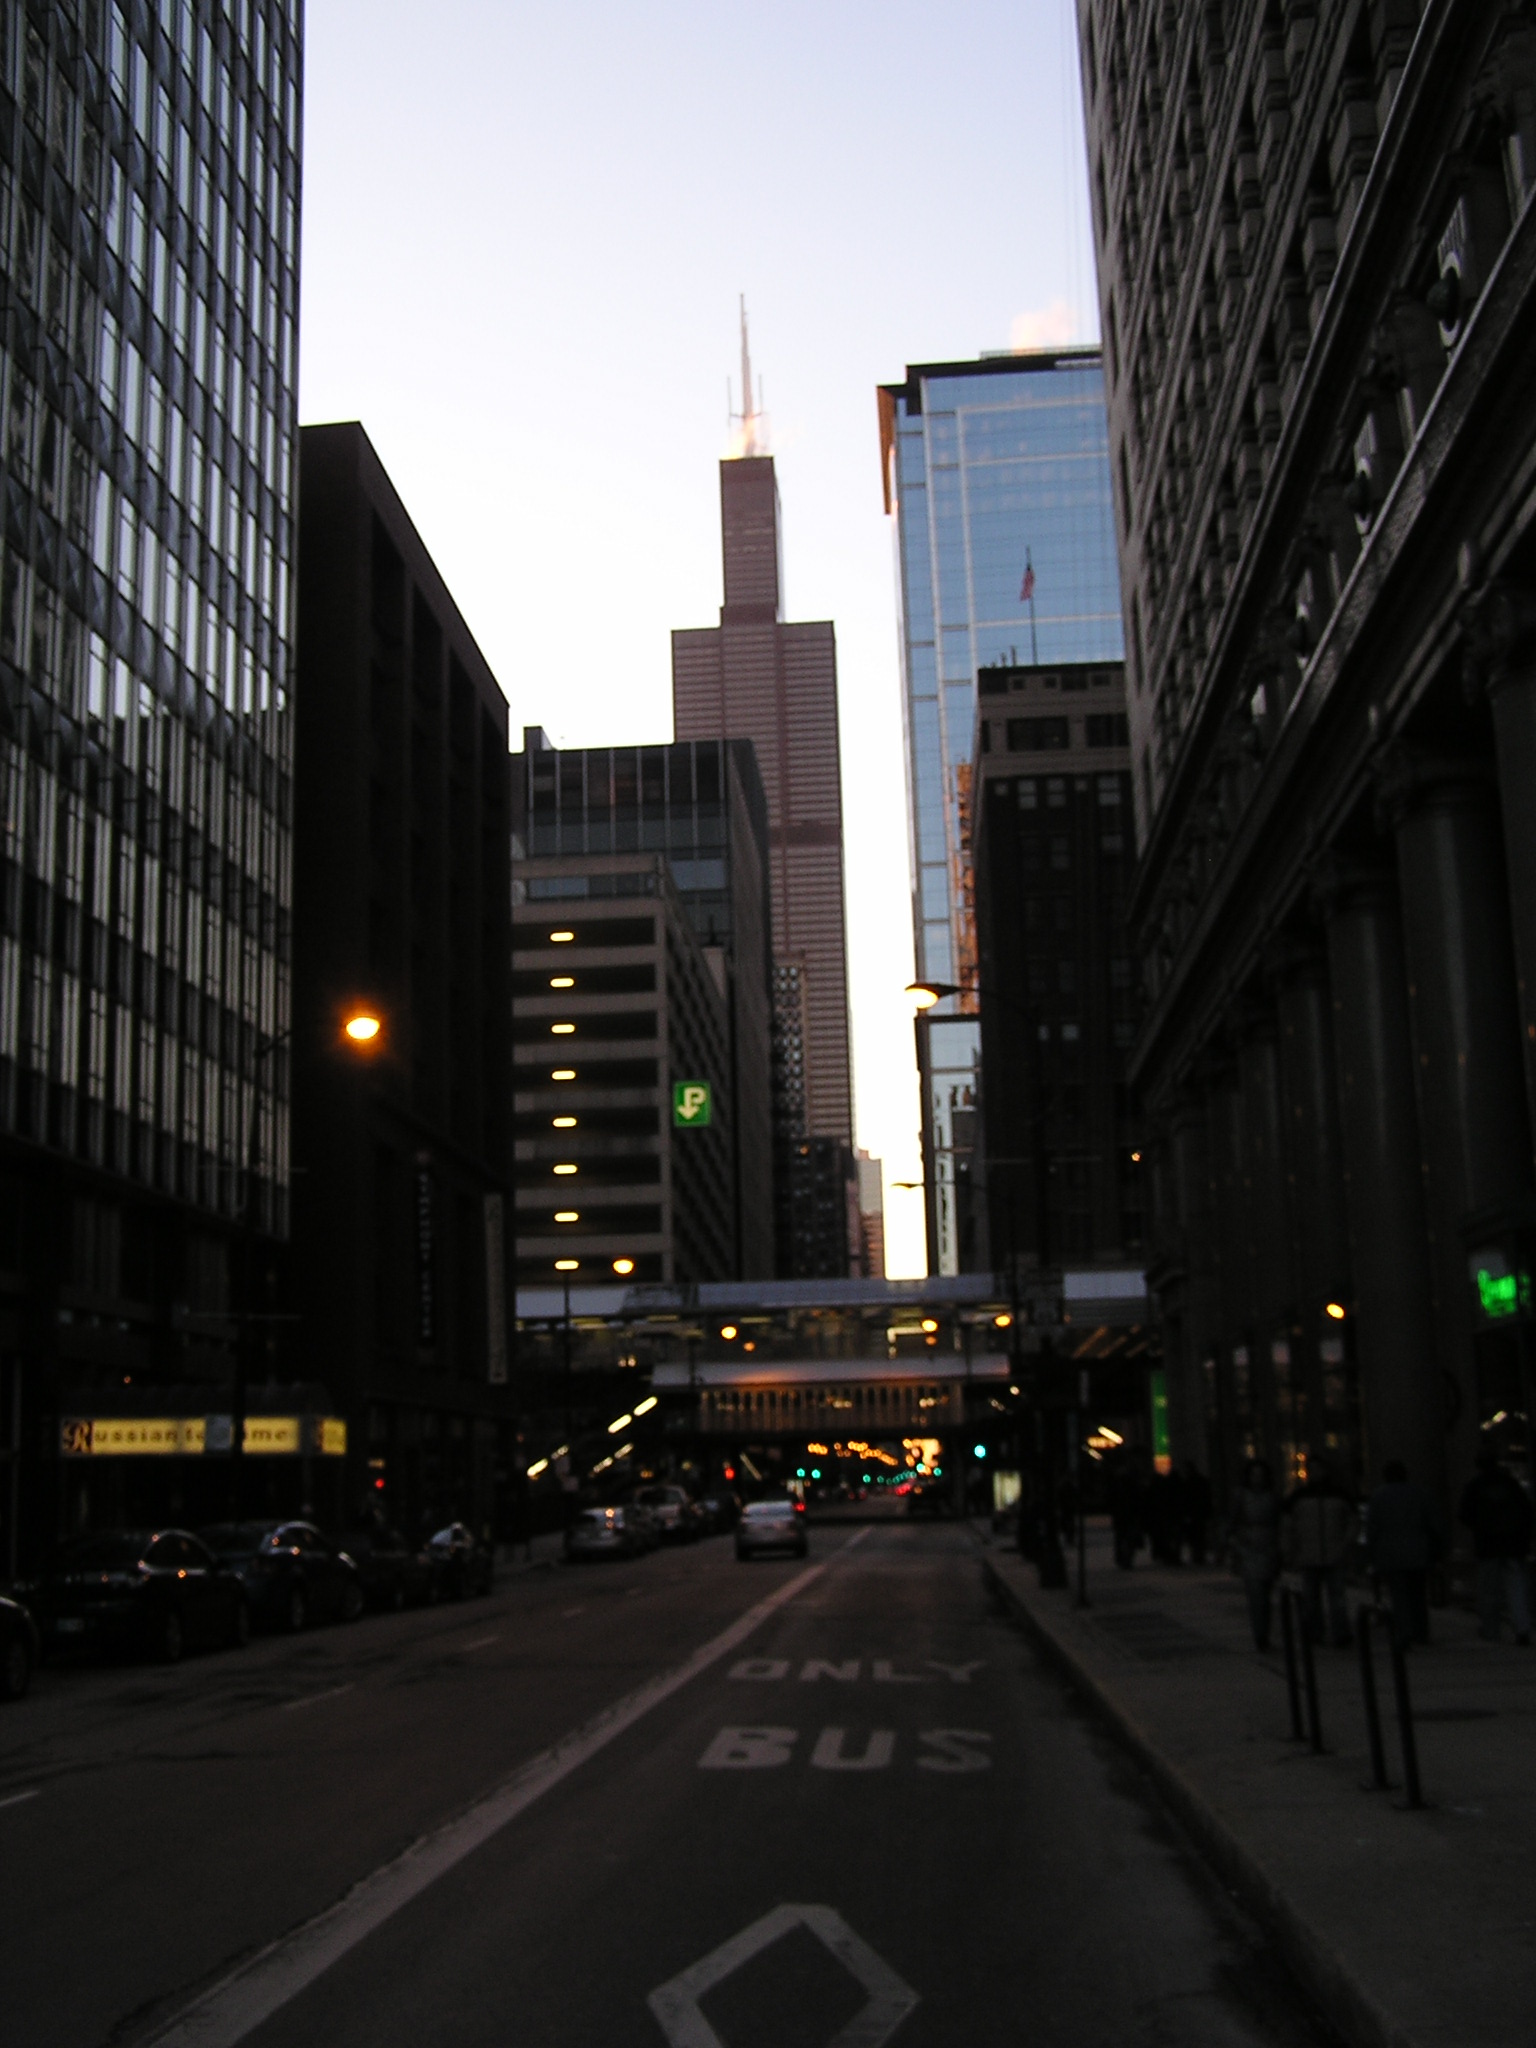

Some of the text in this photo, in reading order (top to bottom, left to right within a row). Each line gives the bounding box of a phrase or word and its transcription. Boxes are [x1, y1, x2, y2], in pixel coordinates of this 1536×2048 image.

[677, 1086, 706, 1119] P
[63, 1420, 178, 1452] Russian
[728, 1659, 985, 1683] ONLY
[697, 1726, 992, 1772] BUS
